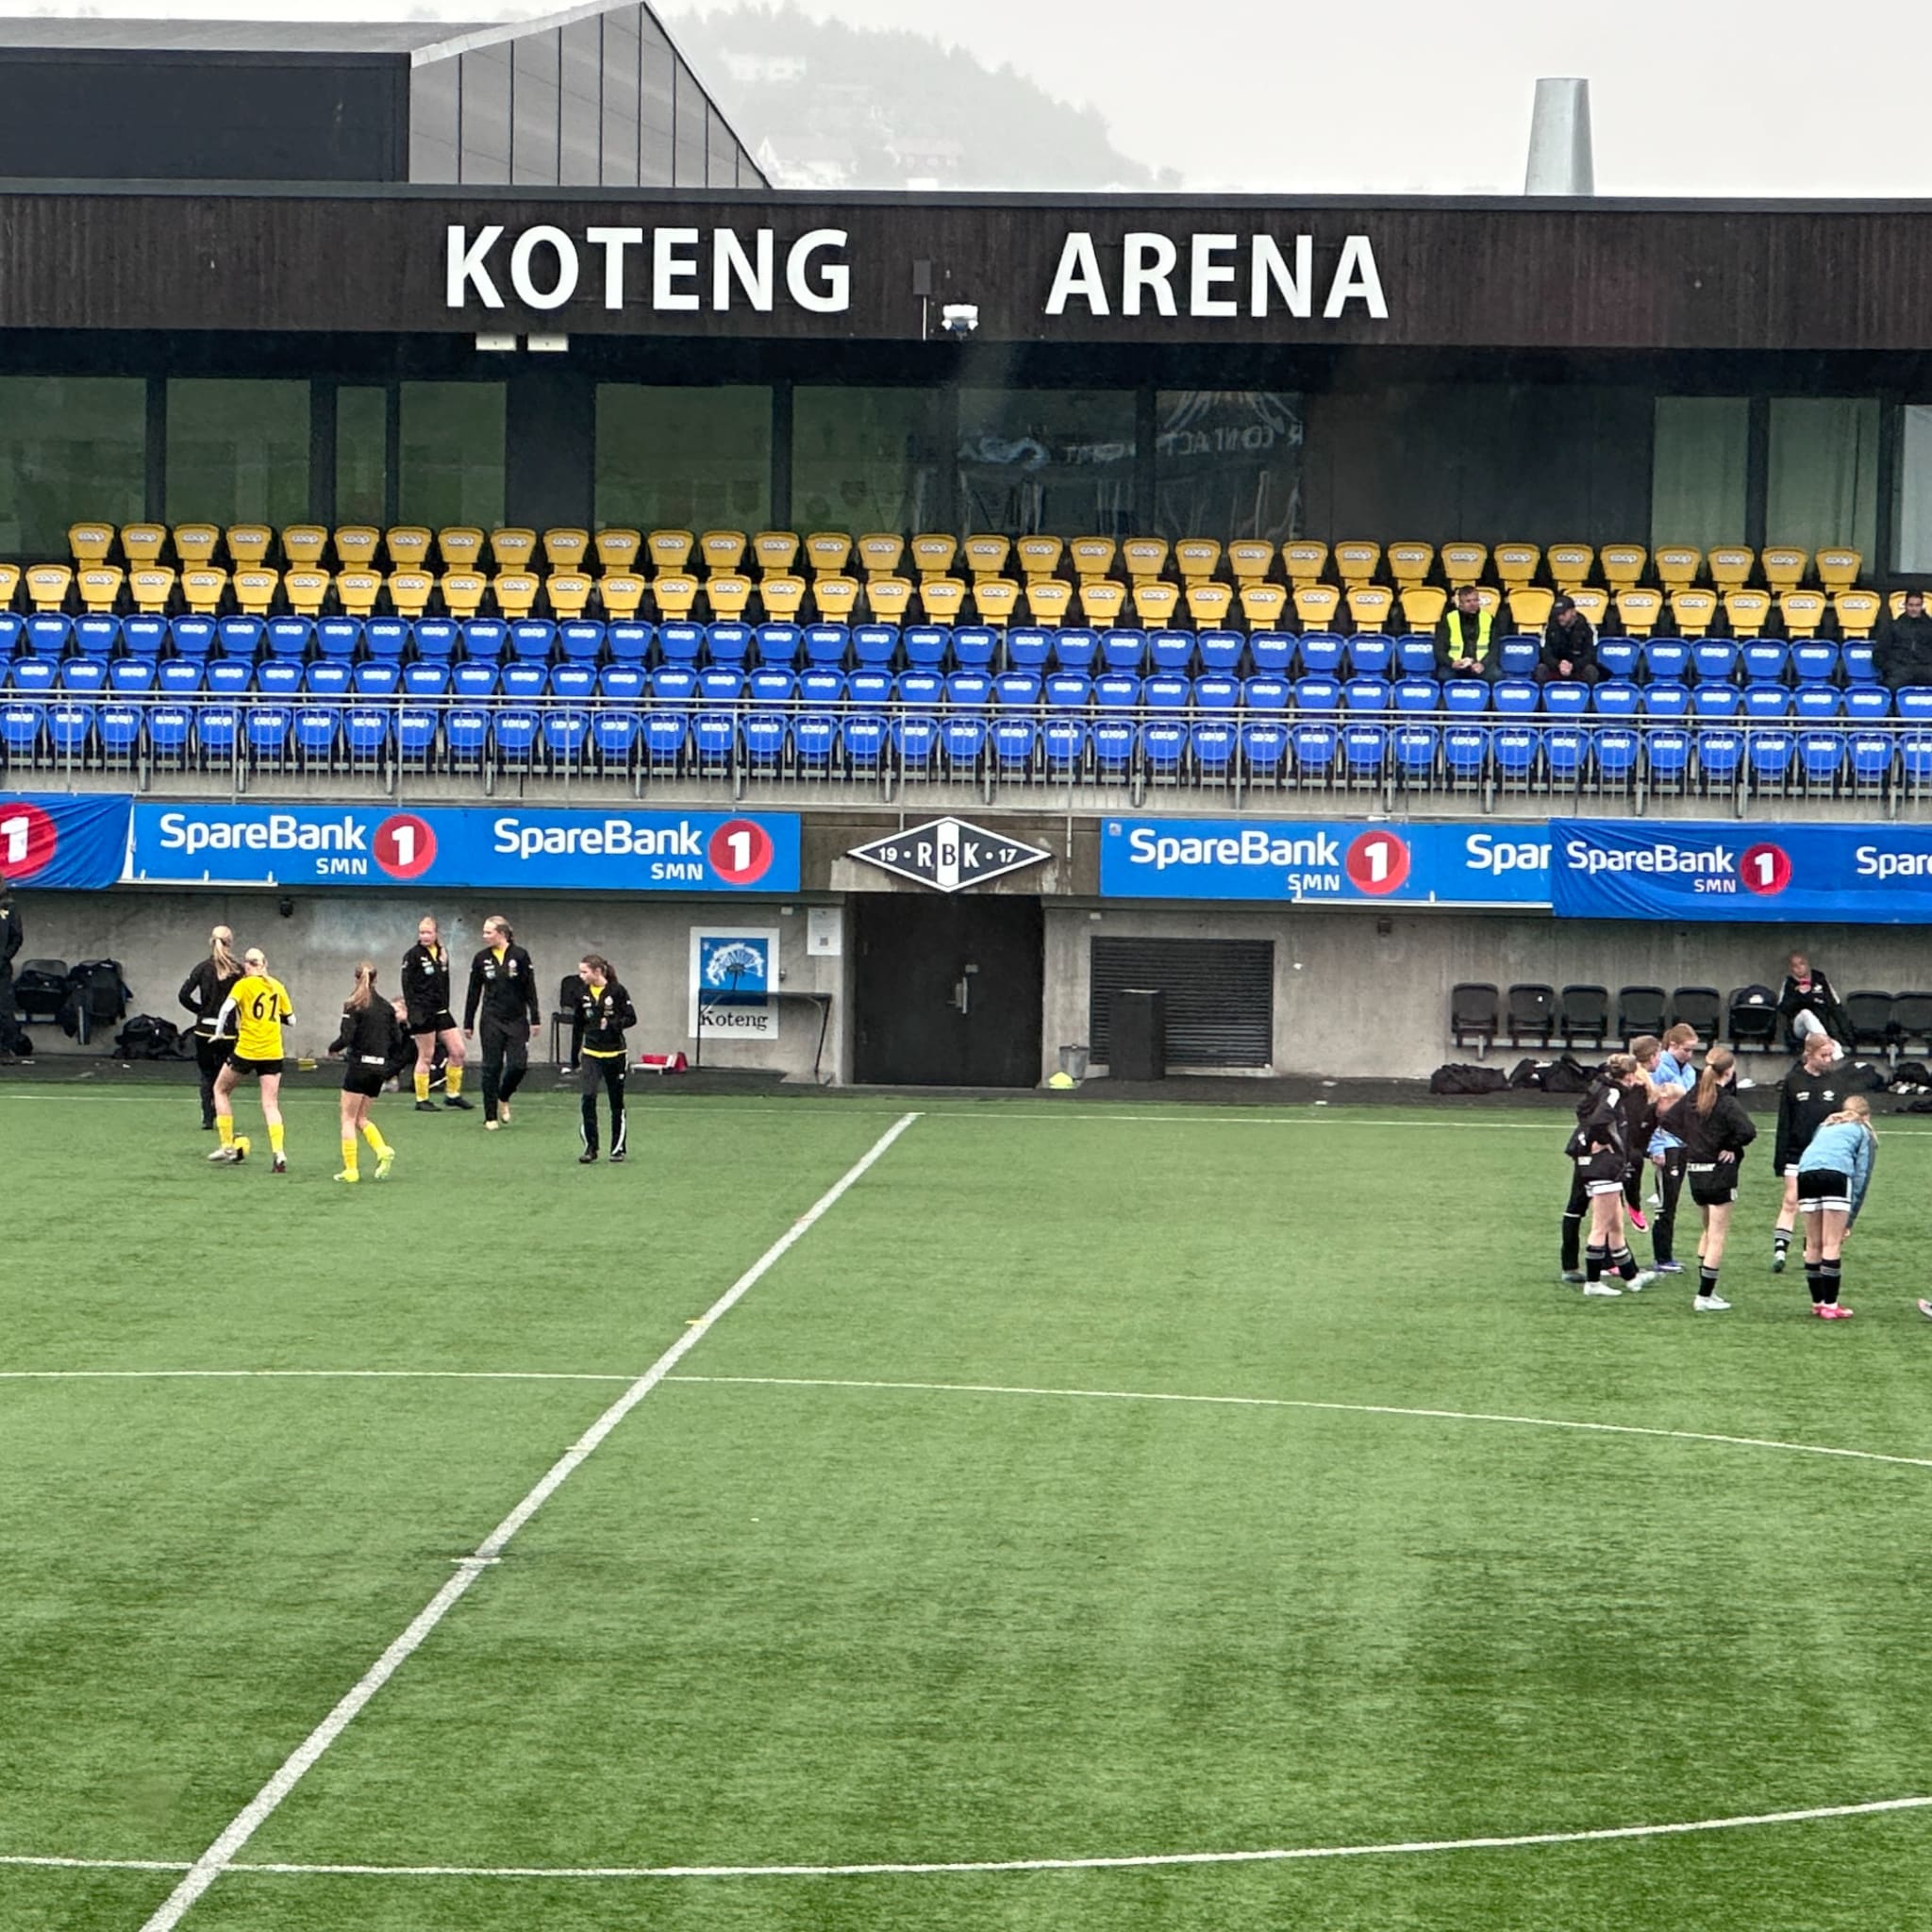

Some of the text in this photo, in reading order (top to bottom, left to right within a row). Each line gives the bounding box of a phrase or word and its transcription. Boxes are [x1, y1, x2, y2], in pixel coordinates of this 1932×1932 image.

[448, 225, 1388, 318] KOTENG ARENA
[1, 817, 28, 862] 1
[161, 814, 413, 865] SpareBank 1
[495, 819, 750, 871] SpareBank 1
[878, 846, 898, 862] 19
[999, 847, 1018, 863] 17
[317, 858, 366, 874] SMN
[1131, 829, 1387, 882] SpareBank 1
[1568, 841, 1773, 885] SpareBank 1
[652, 864, 702, 879] SMN
[1288, 874, 1340, 891] SMN
[1694, 879, 1736, 892] SMN
[252, 991, 278, 1022] 61
[700, 1012, 769, 1031] Koteng
